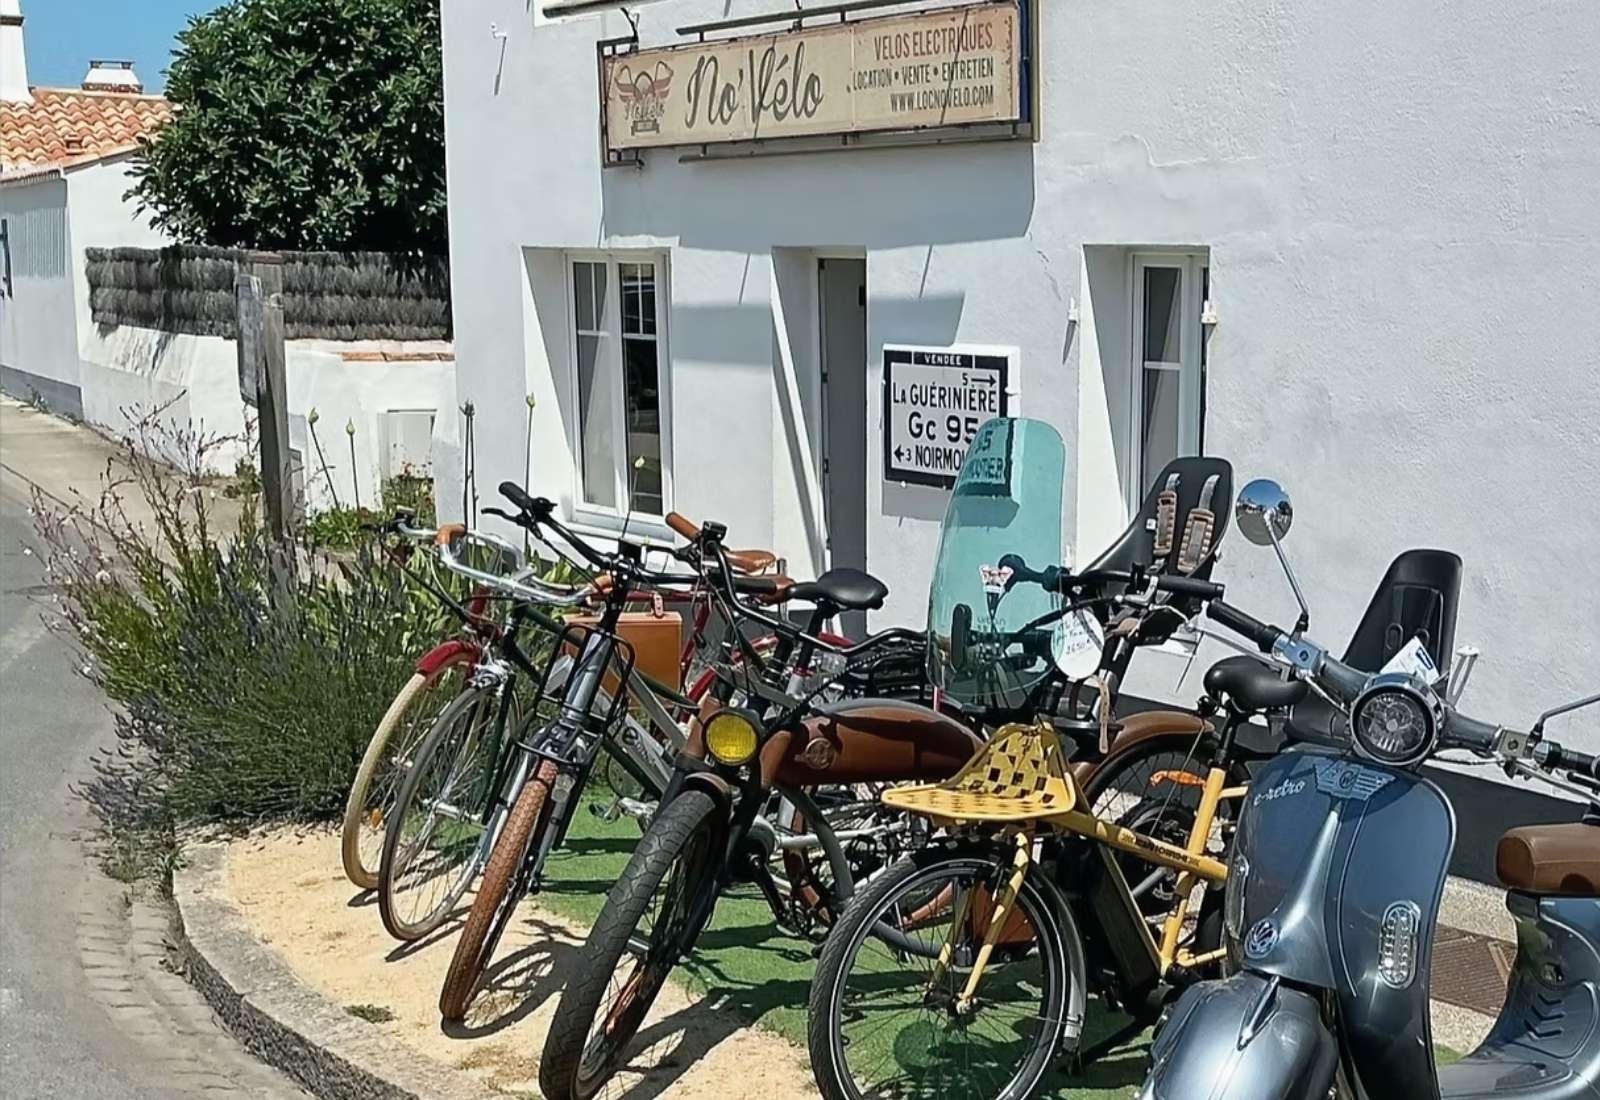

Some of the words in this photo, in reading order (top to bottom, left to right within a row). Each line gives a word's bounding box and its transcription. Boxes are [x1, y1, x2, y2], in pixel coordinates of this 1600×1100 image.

[875, 33, 909, 60] VELOS
[913, 23, 993, 57] ELECTRIQUES
[853, 69, 892, 90] LOCATION
[902, 64, 930, 85] VENTE
[942, 56, 993, 81] ENTRETIEN
[890, 85, 994, 112] WWW.LOCNOVELO.COM
[962, 373, 968, 386] 5
[946, 415, 978, 445] 95
[905, 448, 912, 461] 3
